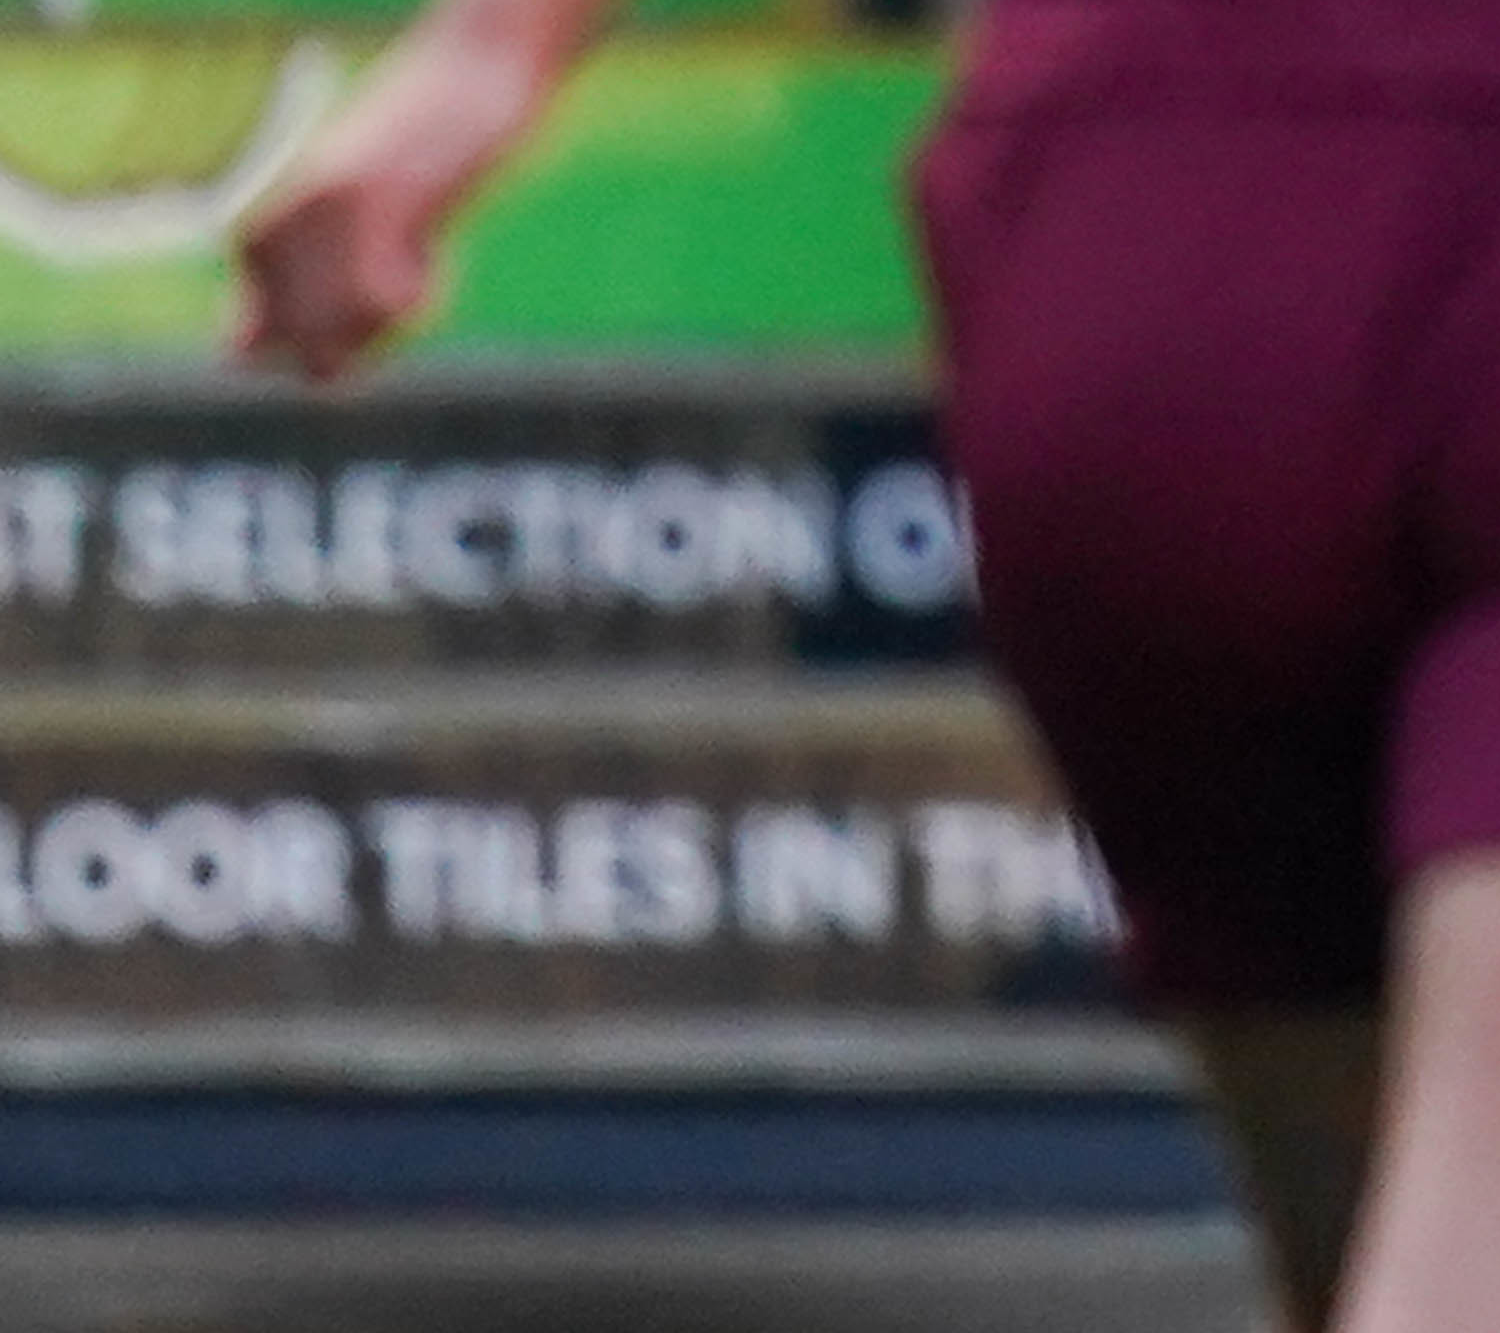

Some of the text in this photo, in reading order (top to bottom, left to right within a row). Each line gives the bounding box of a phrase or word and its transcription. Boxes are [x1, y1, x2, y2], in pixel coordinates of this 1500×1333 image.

[112, 462, 838, 610] SELECTION
[366, 797, 722, 946] TILES
[730, 799, 898, 943] IN
